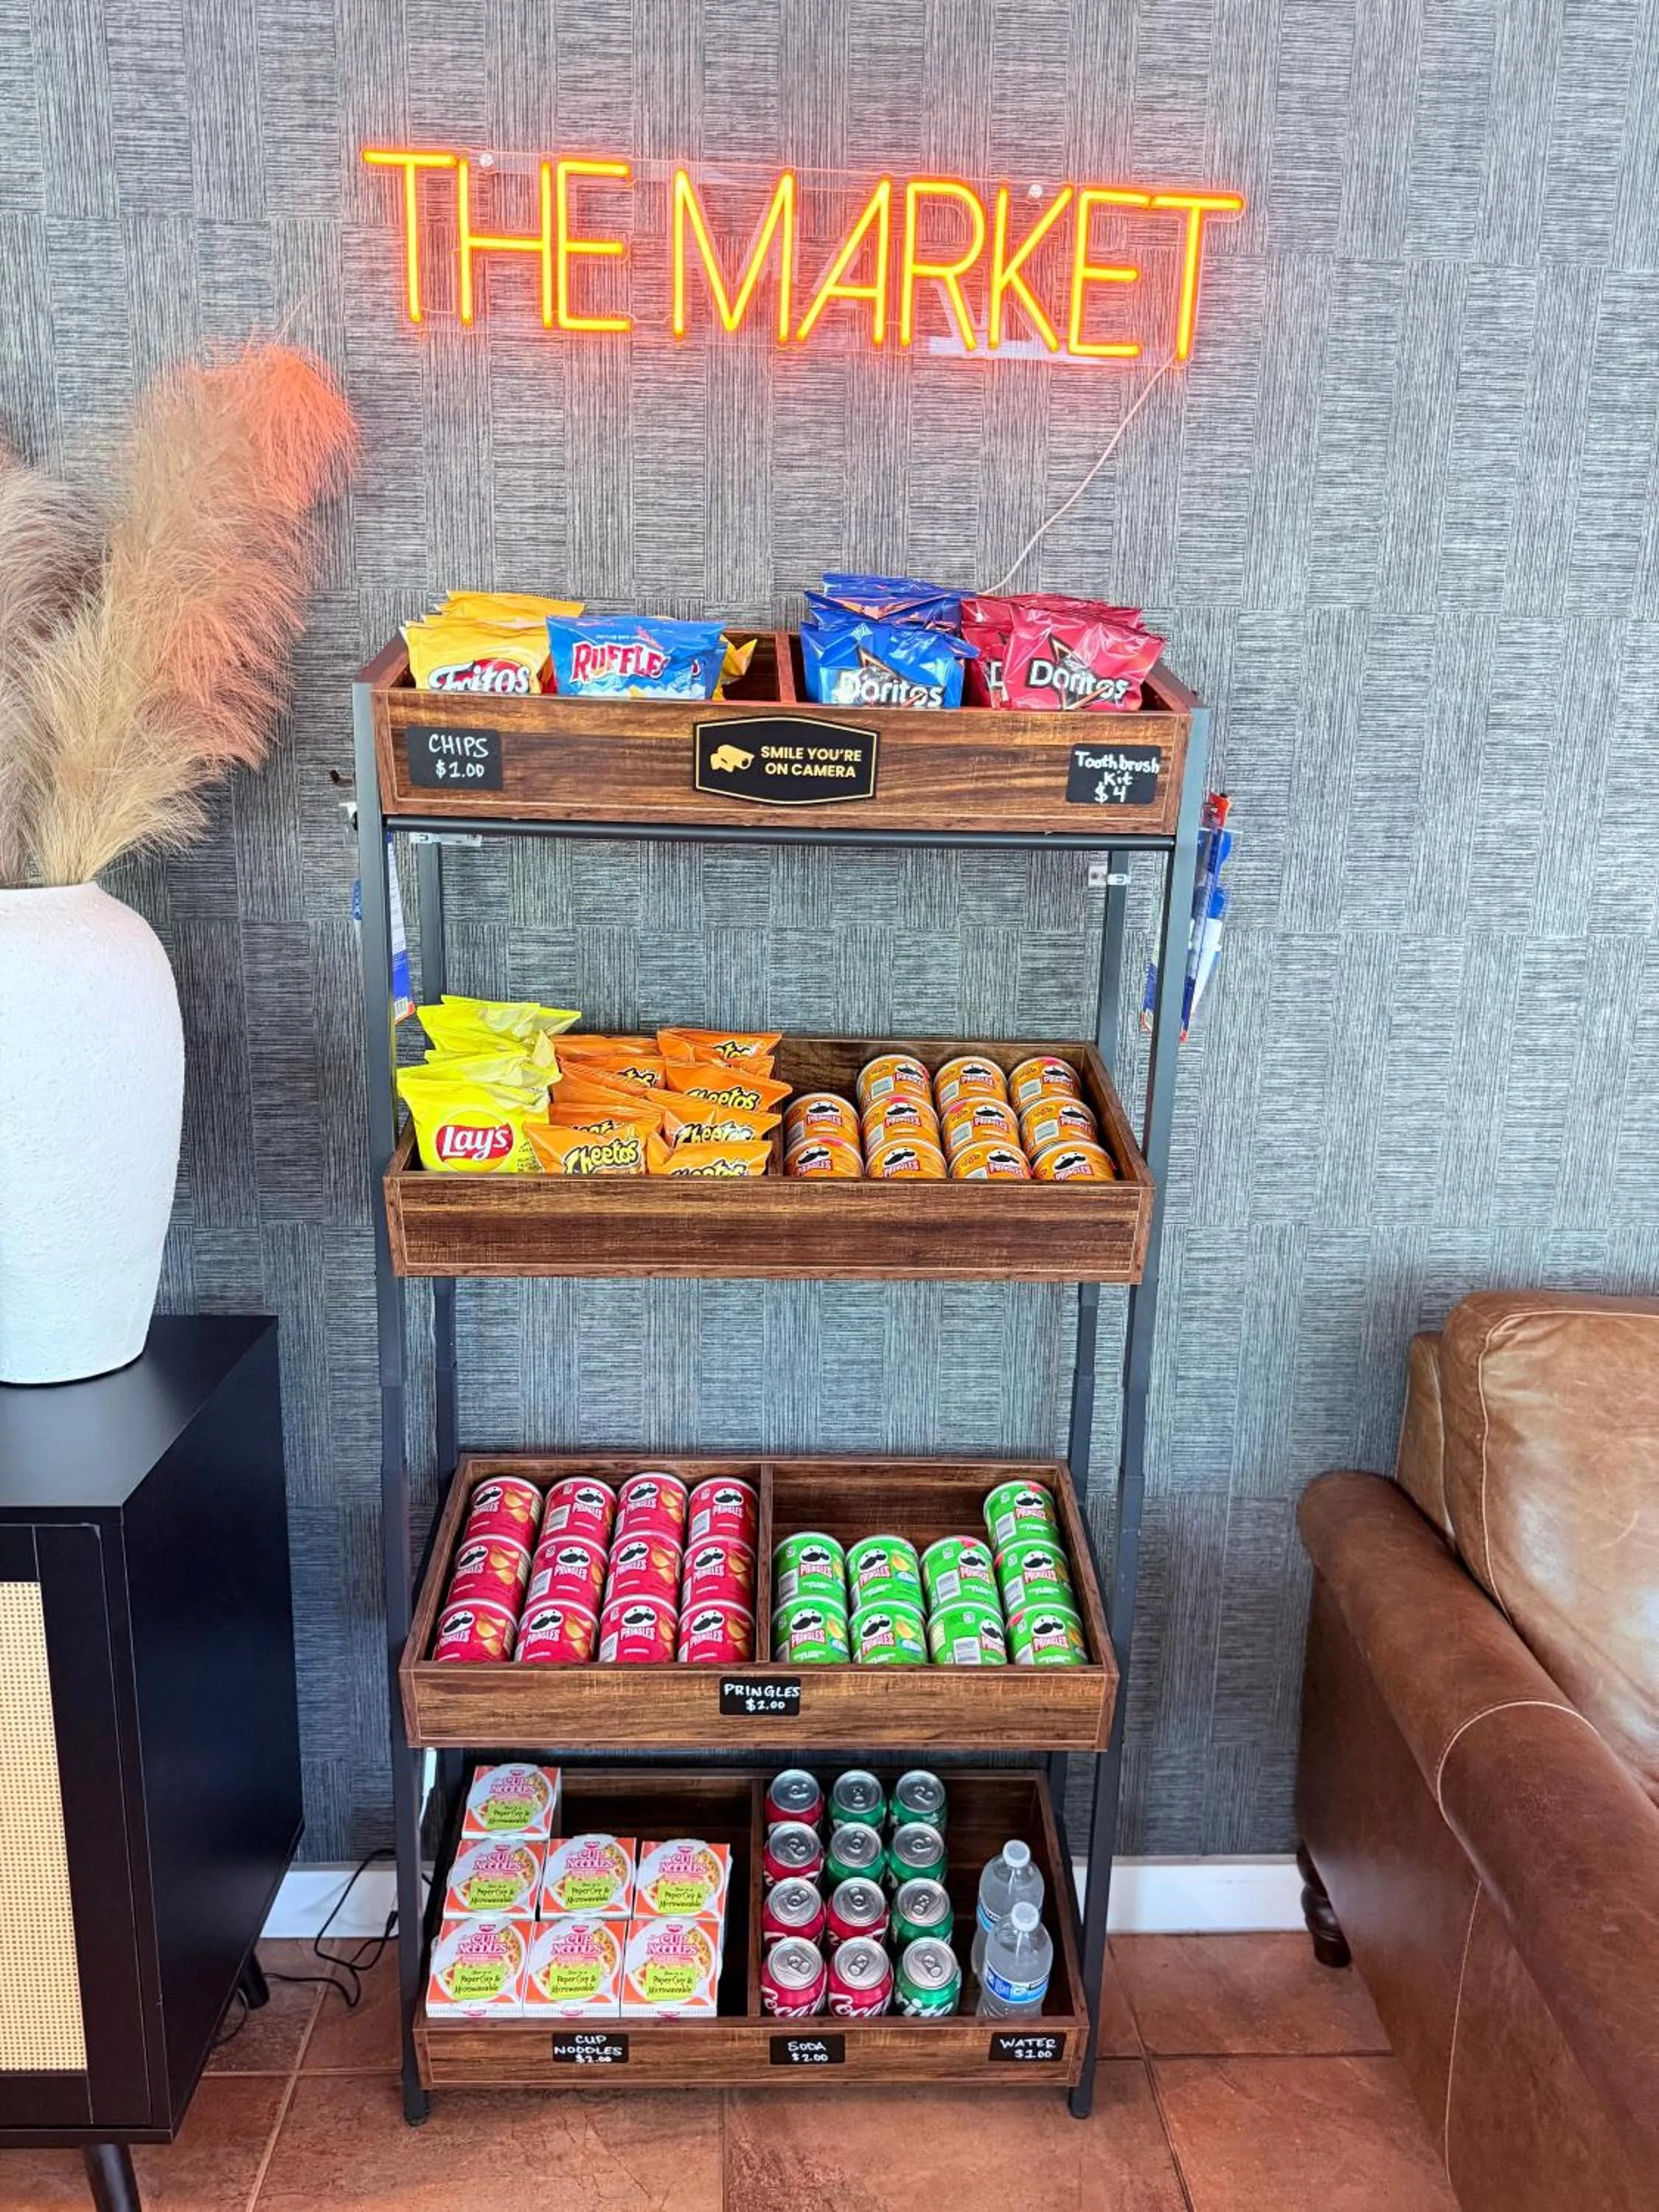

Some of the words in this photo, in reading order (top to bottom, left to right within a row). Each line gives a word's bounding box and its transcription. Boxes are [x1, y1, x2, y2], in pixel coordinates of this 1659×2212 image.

[364, 150, 631, 331] THE
[673, 167, 1245, 359] MARKET
[1029, 659, 1130, 700] Doritos
[838, 672, 944, 707] Doritos
[428, 733, 489, 758] CHIPS
[760, 745, 804, 759] SMILE
[807, 748, 863, 762] YOU'RE
[436, 758, 484, 779] $1.00
[765, 762, 788, 775] ON
[791, 764, 857, 779] CAMERA
[1104, 770, 1133, 787] Kit
[441, 1125, 509, 1163] Lay's
[724, 1683, 801, 1697] PRINGLES
[745, 1697, 785, 1712] $2.00
[575, 2035, 607, 2045] CUP
[787, 2040, 827, 2052] SODA
[999, 2037, 1057, 2049] WATER
[554, 2046, 623, 2056] NOODLES
